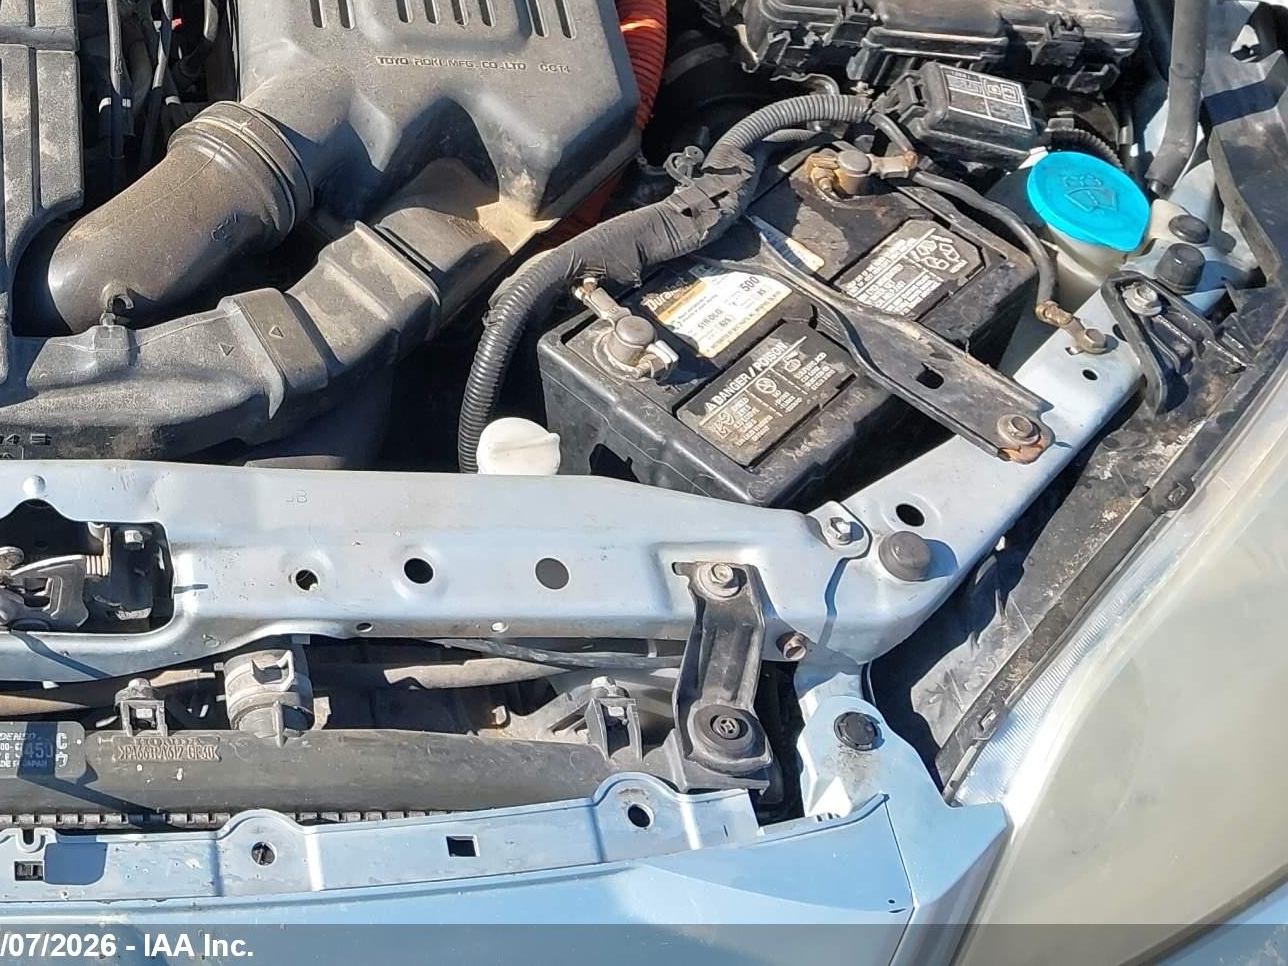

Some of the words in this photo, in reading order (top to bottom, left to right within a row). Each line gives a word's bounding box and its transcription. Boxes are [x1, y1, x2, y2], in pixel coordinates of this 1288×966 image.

[376, 55, 409, 65] TOYO
[739, 275, 760, 293] 500
[712, 371, 751, 405] DANGER
[752, 340, 789, 372] POISON
